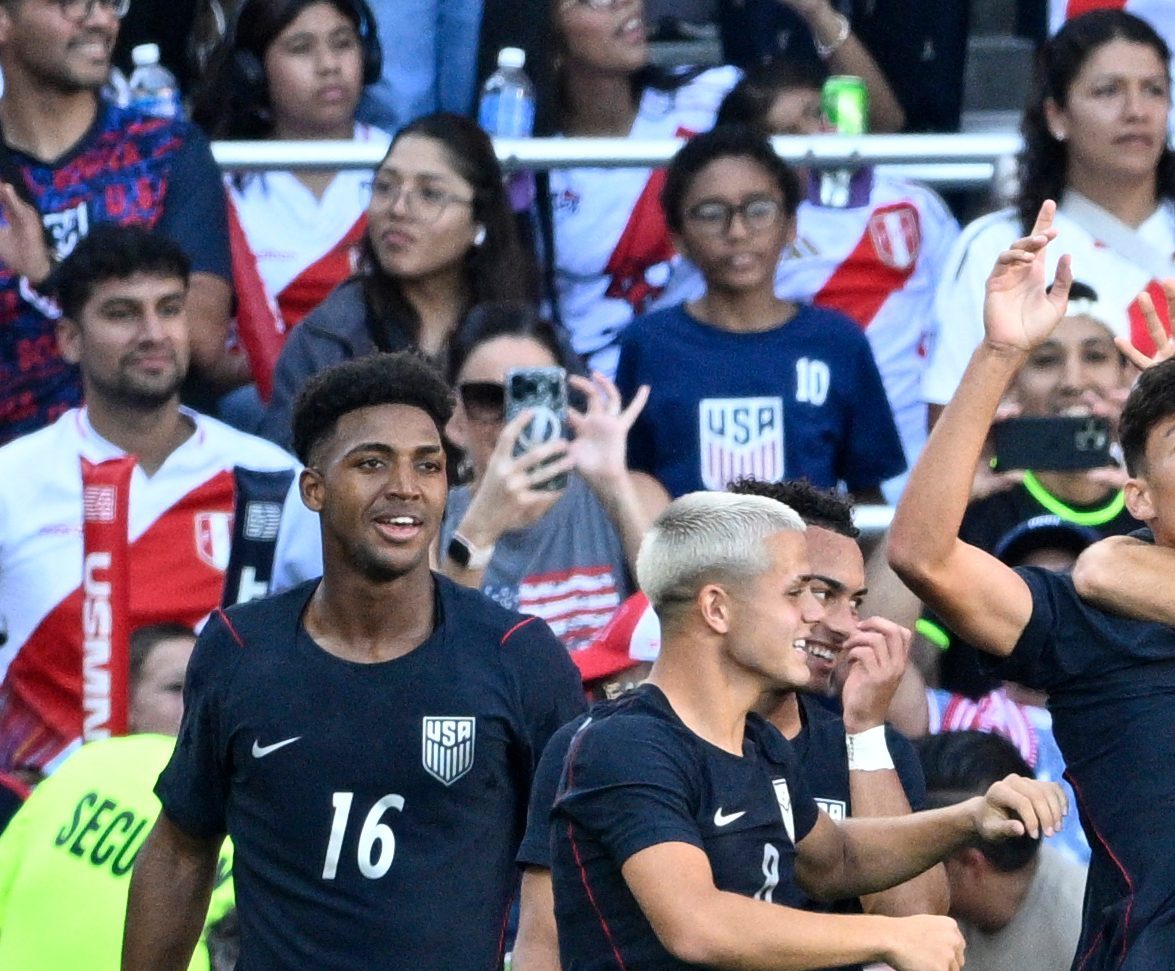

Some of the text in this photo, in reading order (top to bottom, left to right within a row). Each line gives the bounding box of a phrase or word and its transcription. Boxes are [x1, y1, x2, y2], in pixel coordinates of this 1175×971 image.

[796, 357, 830, 406] 10
[709, 406, 775, 445] USA
[426, 720, 471, 747] USA
[322, 792, 405, 879] 16
